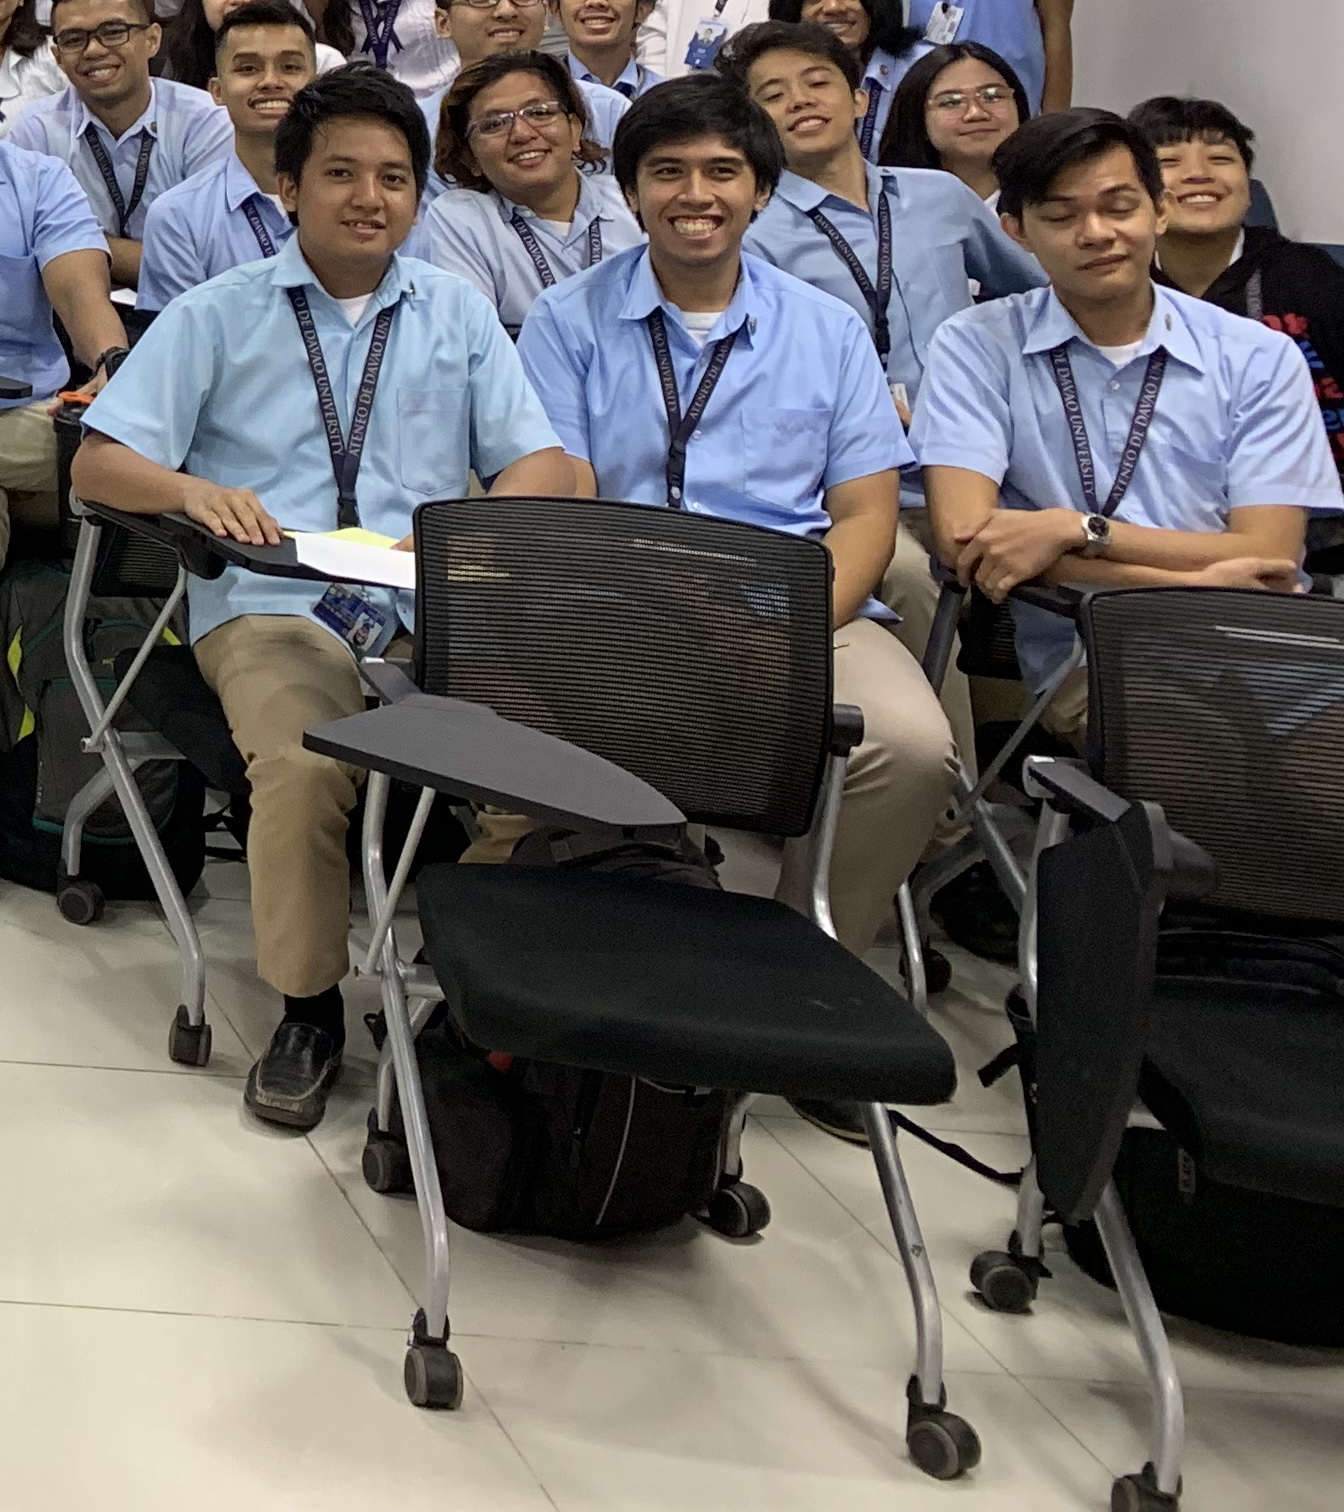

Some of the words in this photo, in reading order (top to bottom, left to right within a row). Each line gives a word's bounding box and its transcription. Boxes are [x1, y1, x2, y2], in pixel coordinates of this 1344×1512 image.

[250, 215, 269, 247] DAVAO
[514, 220, 528, 235] DE
[522, 233, 547, 270] DAVAO
[297, 309, 311, 327] DE
[301, 329, 325, 374] DAVAO
[363, 341, 384, 384] DAVAO
[358, 385, 374, 404] DE
[657, 348, 679, 413] UNIVERSITY
[689, 379, 714, 420] ATENEO
[708, 364, 720, 379] DE
[1056, 366, 1077, 413] DAVAO
[1133, 381, 1158, 426] DAVAO
[311, 375, 348, 457] UNIVERSITY
[346, 405, 371, 457] ATENEO
[1128, 429, 1143, 446] DE
[1066, 413, 1099, 497] UNIVERSITY
[1110, 448, 1138, 501] ATENEO
